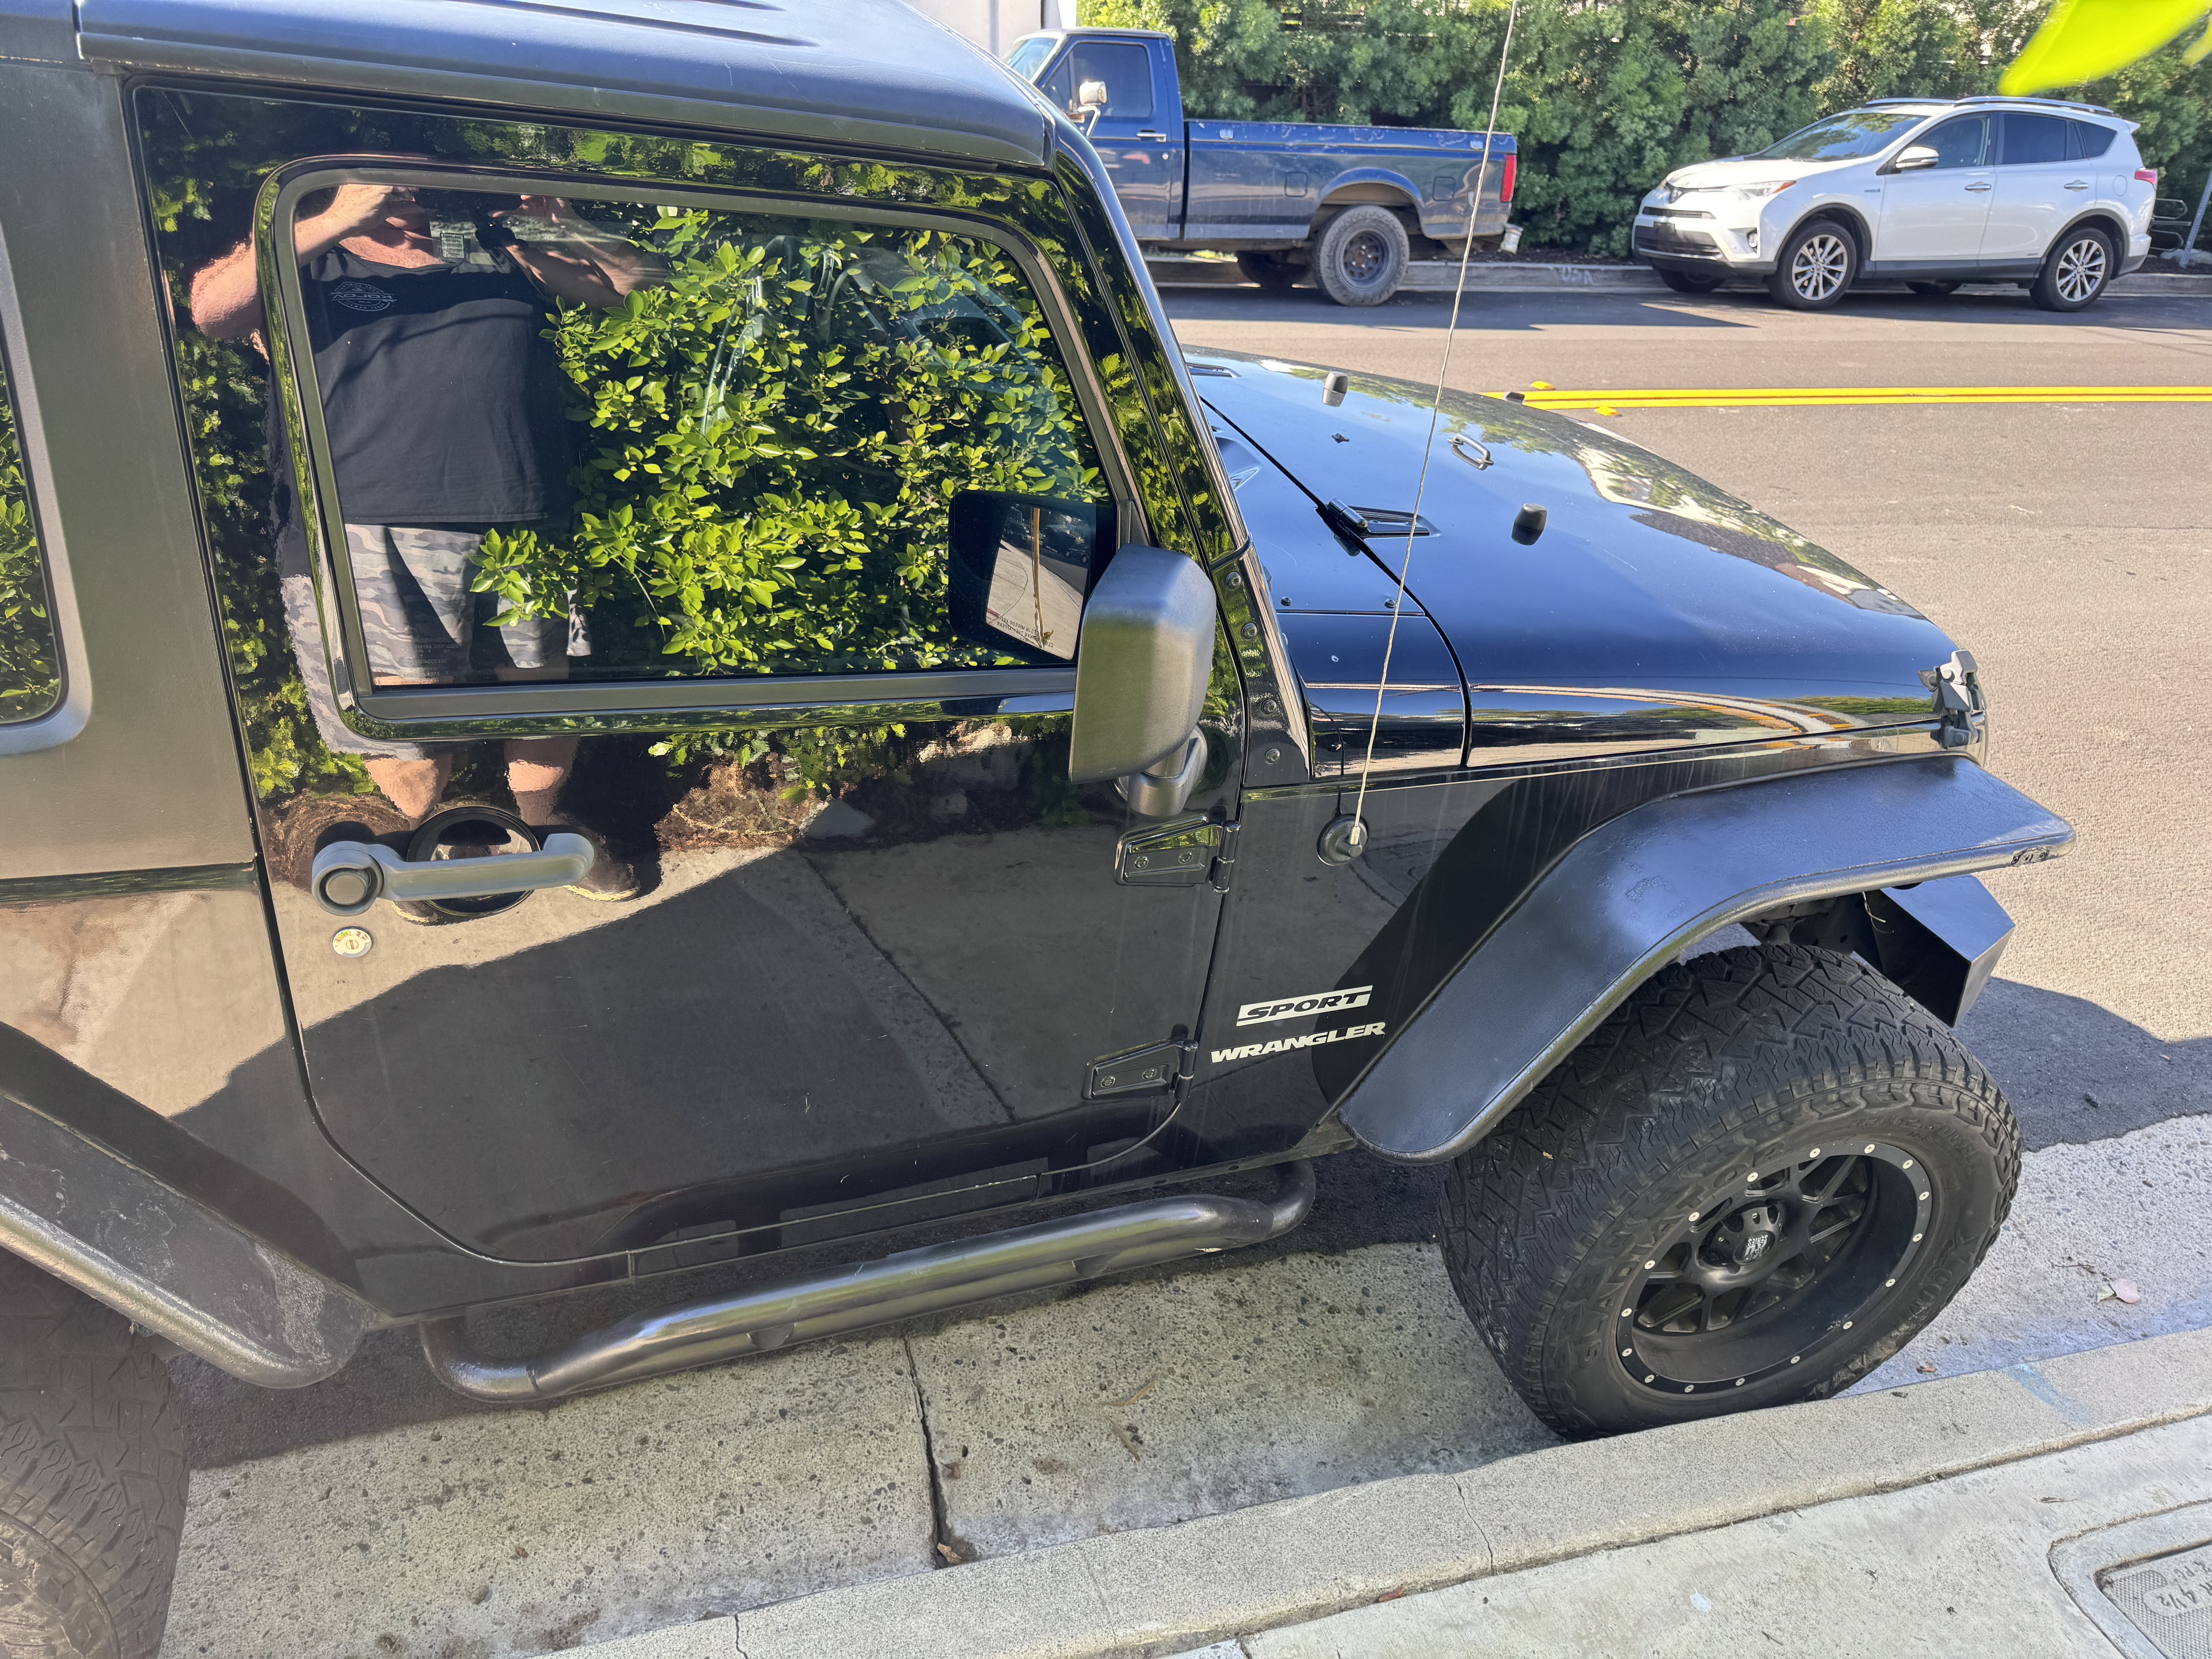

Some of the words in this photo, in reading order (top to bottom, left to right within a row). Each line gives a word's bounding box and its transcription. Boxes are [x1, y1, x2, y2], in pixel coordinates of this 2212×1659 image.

[1247, 992, 1367, 1019] SPORT
[1211, 1022, 1386, 1063] WRANGLER
[1580, 1134, 1783, 1370] GLADIATOR
[1747, 1234, 1768, 1247] SERIES
